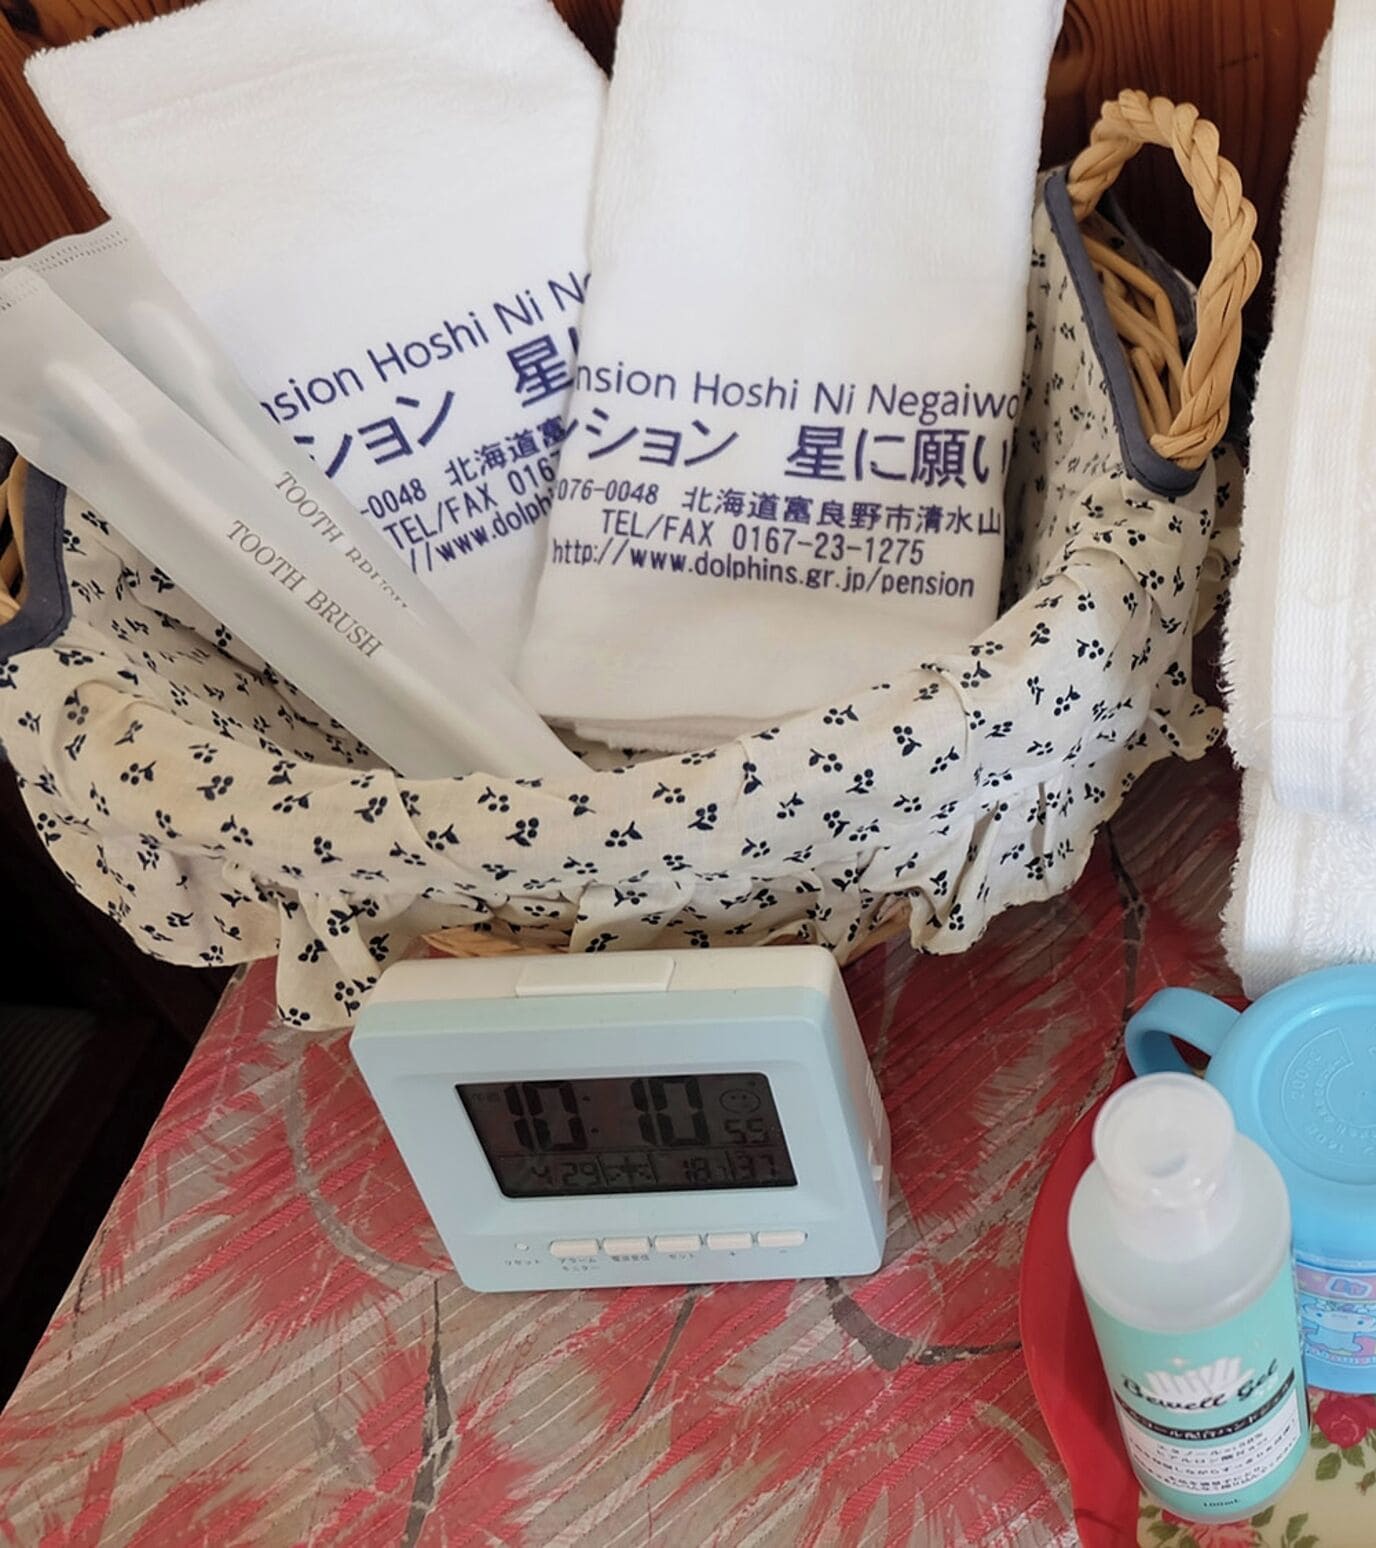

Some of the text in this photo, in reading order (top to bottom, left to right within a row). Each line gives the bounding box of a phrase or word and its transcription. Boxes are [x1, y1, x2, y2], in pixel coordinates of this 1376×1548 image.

[366, 312, 489, 383] Hoshi
[493, 289, 544, 335] Ni
[548, 271, 592, 312] N
[693, 371, 799, 411] Hoshi
[813, 381, 855, 416] Ni
[867, 383, 1020, 426] Negaiwo
[565, 406, 740, 468] ション
[275, 471, 346, 544] TOOTH
[383, 450, 560, 550] TEL/FAX 016
[557, 478, 659, 506] 076-0048
[552, 538, 974, 599] http://www.dolphins.gr.jp/pension
[602, 509, 925, 567] TEL/FAX 0167-23-1275
[226, 520, 308, 593] TOOTH
[304, 589, 384, 659] BRUSH
